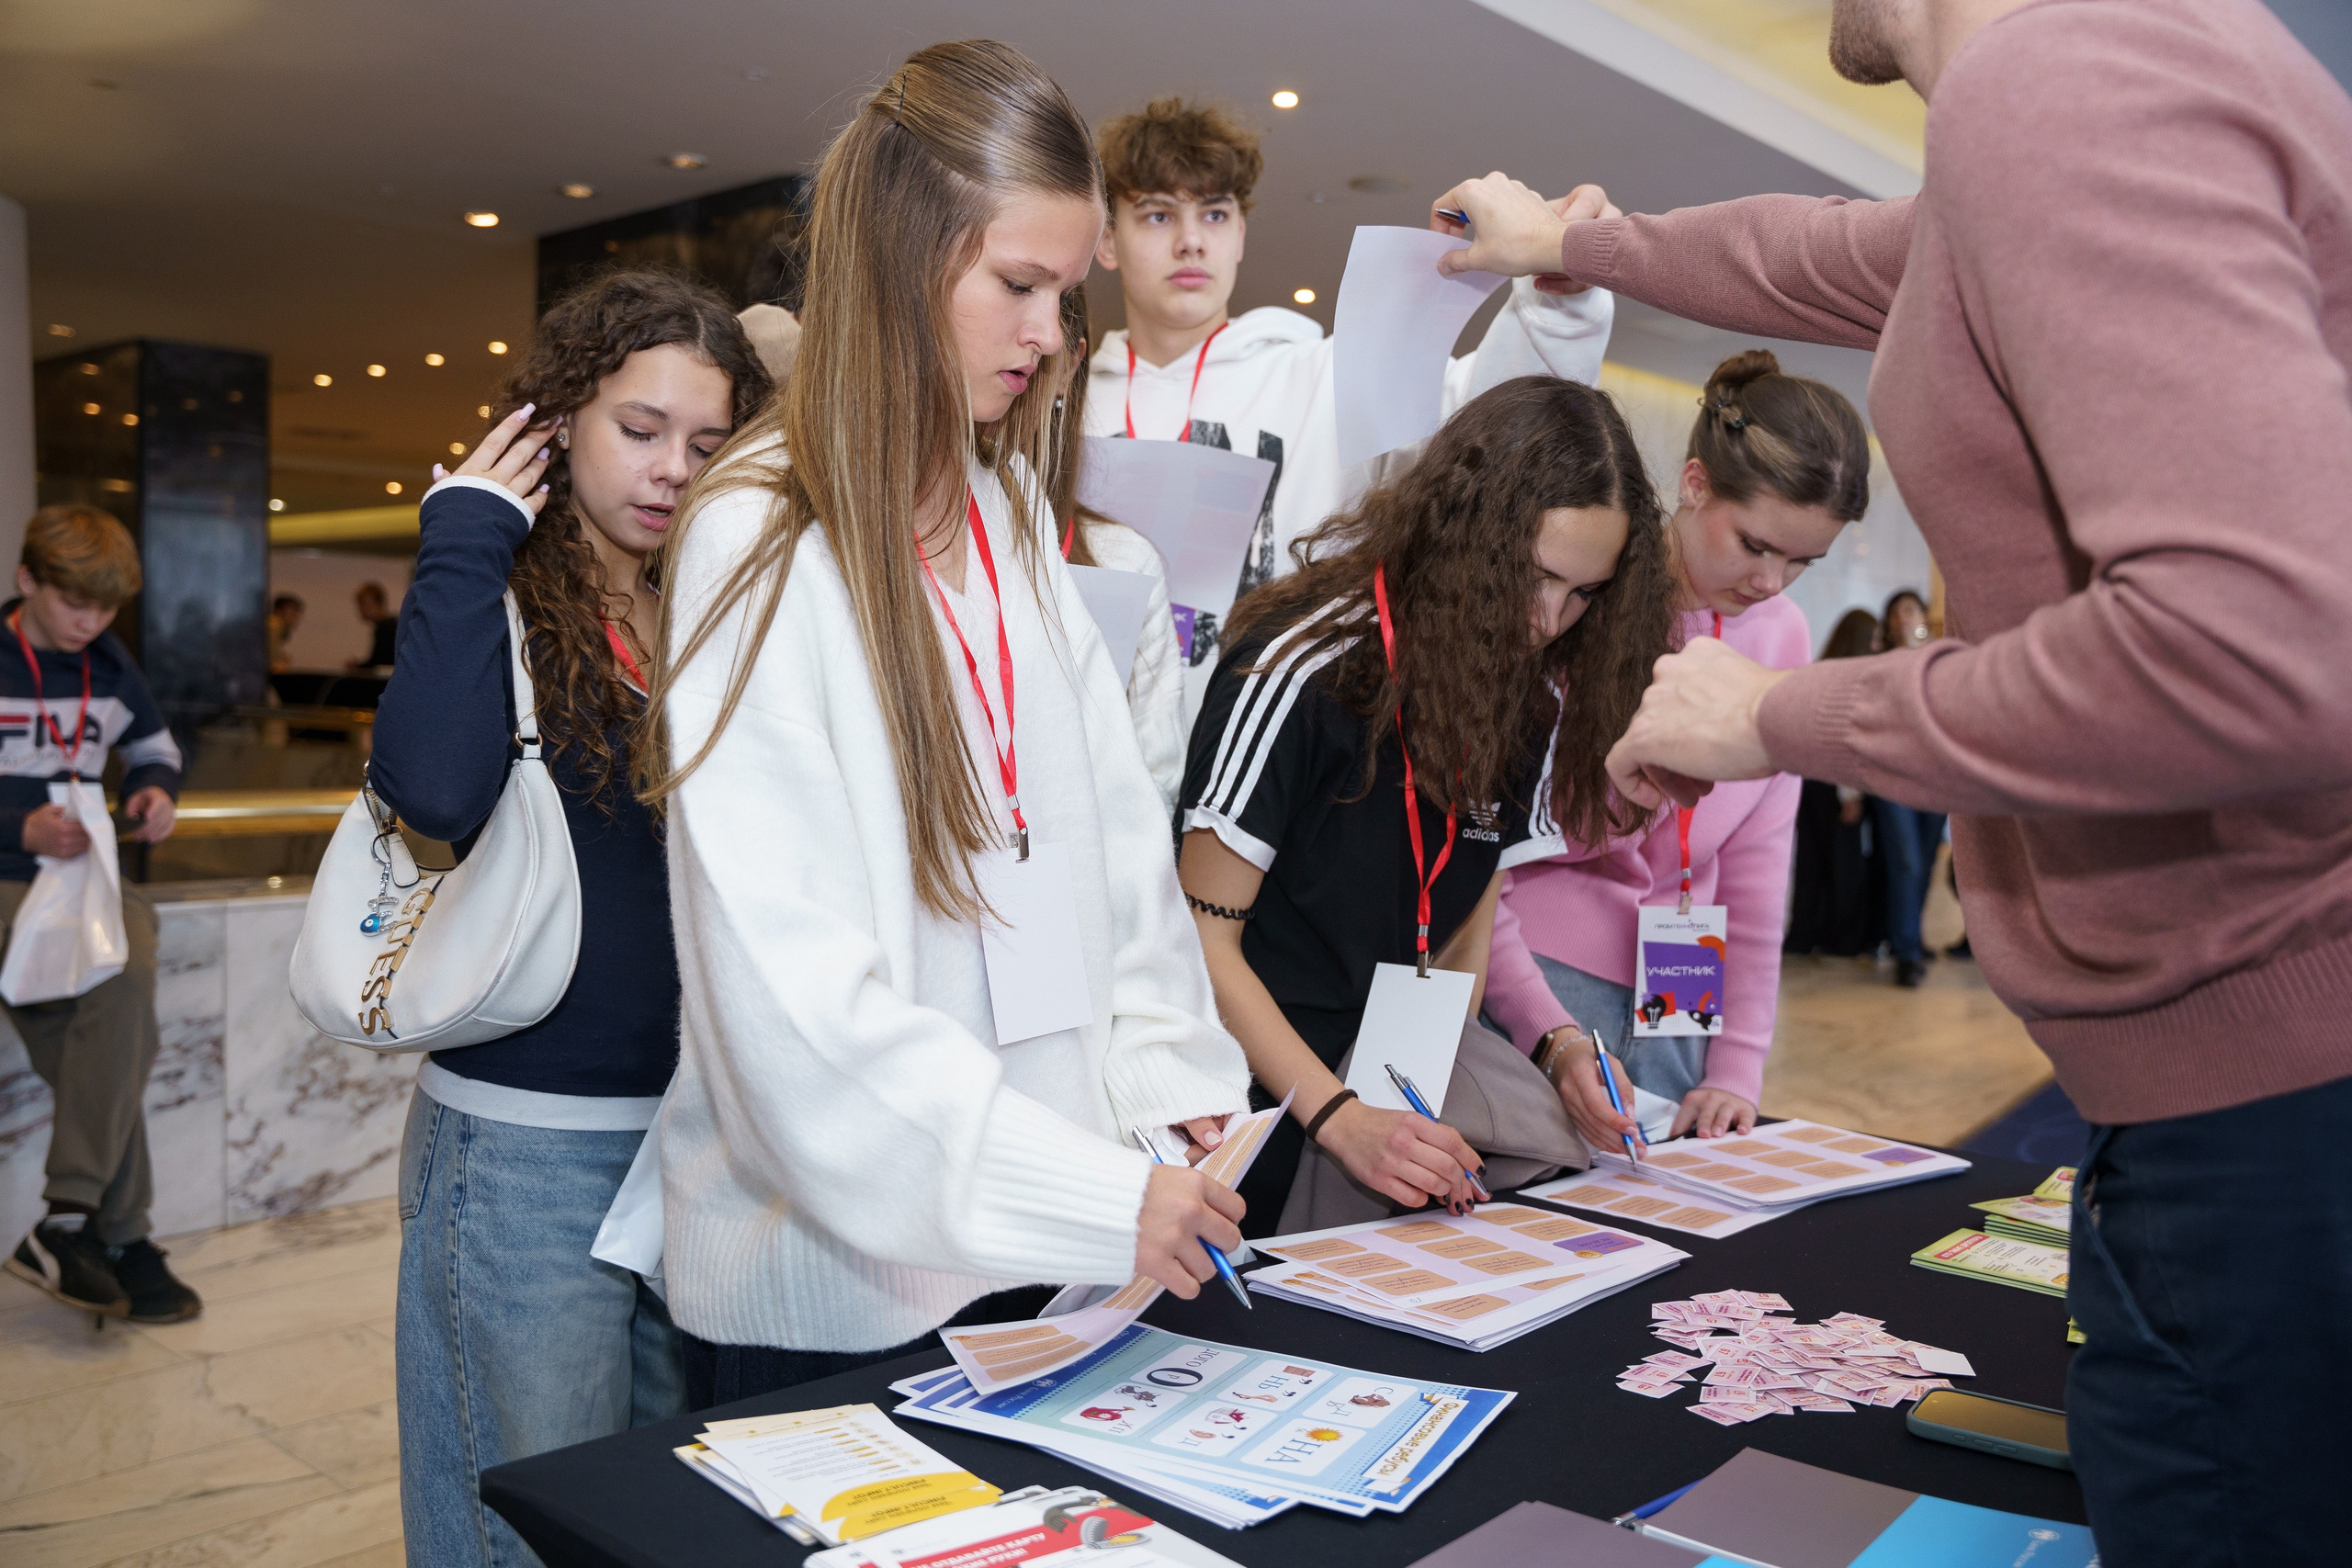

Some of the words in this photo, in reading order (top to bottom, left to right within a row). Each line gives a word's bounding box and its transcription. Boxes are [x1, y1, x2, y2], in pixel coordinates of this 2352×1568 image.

[0, 714, 101, 750] FILA
[1463, 828, 1499, 842] adidas
[358, 886, 435, 1036] GUESS
[1646, 965, 1716, 977] УЧАСТНИК
[1186, 1348, 1220, 1367] ДОГО
[1258, 1374, 1290, 1389] НЬ
[1407, 1402, 1460, 1448] Финансовые
[1264, 1438, 1323, 1462] НА
[1377, 1447, 1414, 1475] ребусы
[931, 1543, 1007, 1567] ОТДАВАЙТЕ
[1004, 1532, 1046, 1549] КАРТУ
[987, 1547, 1028, 1563] РУКИ!
